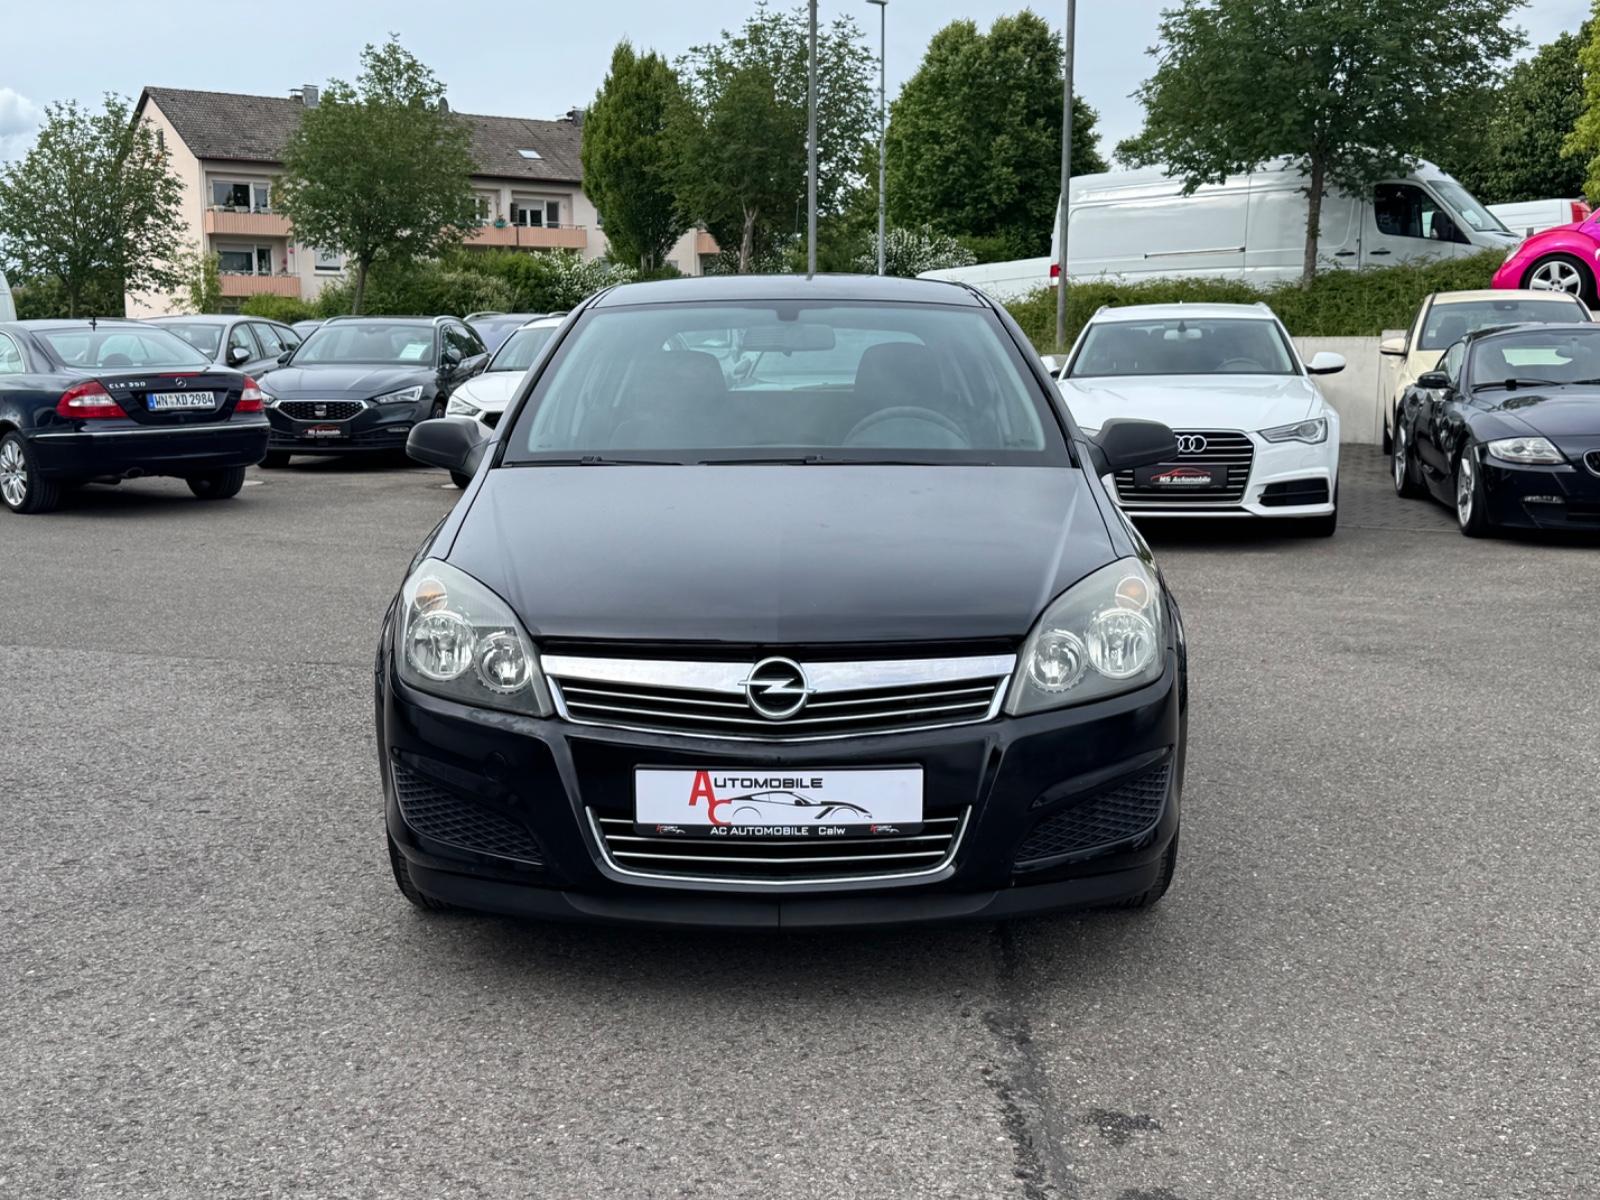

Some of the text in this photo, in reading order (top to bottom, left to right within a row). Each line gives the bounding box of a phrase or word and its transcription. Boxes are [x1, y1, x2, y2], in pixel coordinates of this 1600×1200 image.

[155, 391, 214, 409] WN XD 2984
[710, 826, 846, 836] AC AUTOMOBILE Calw
